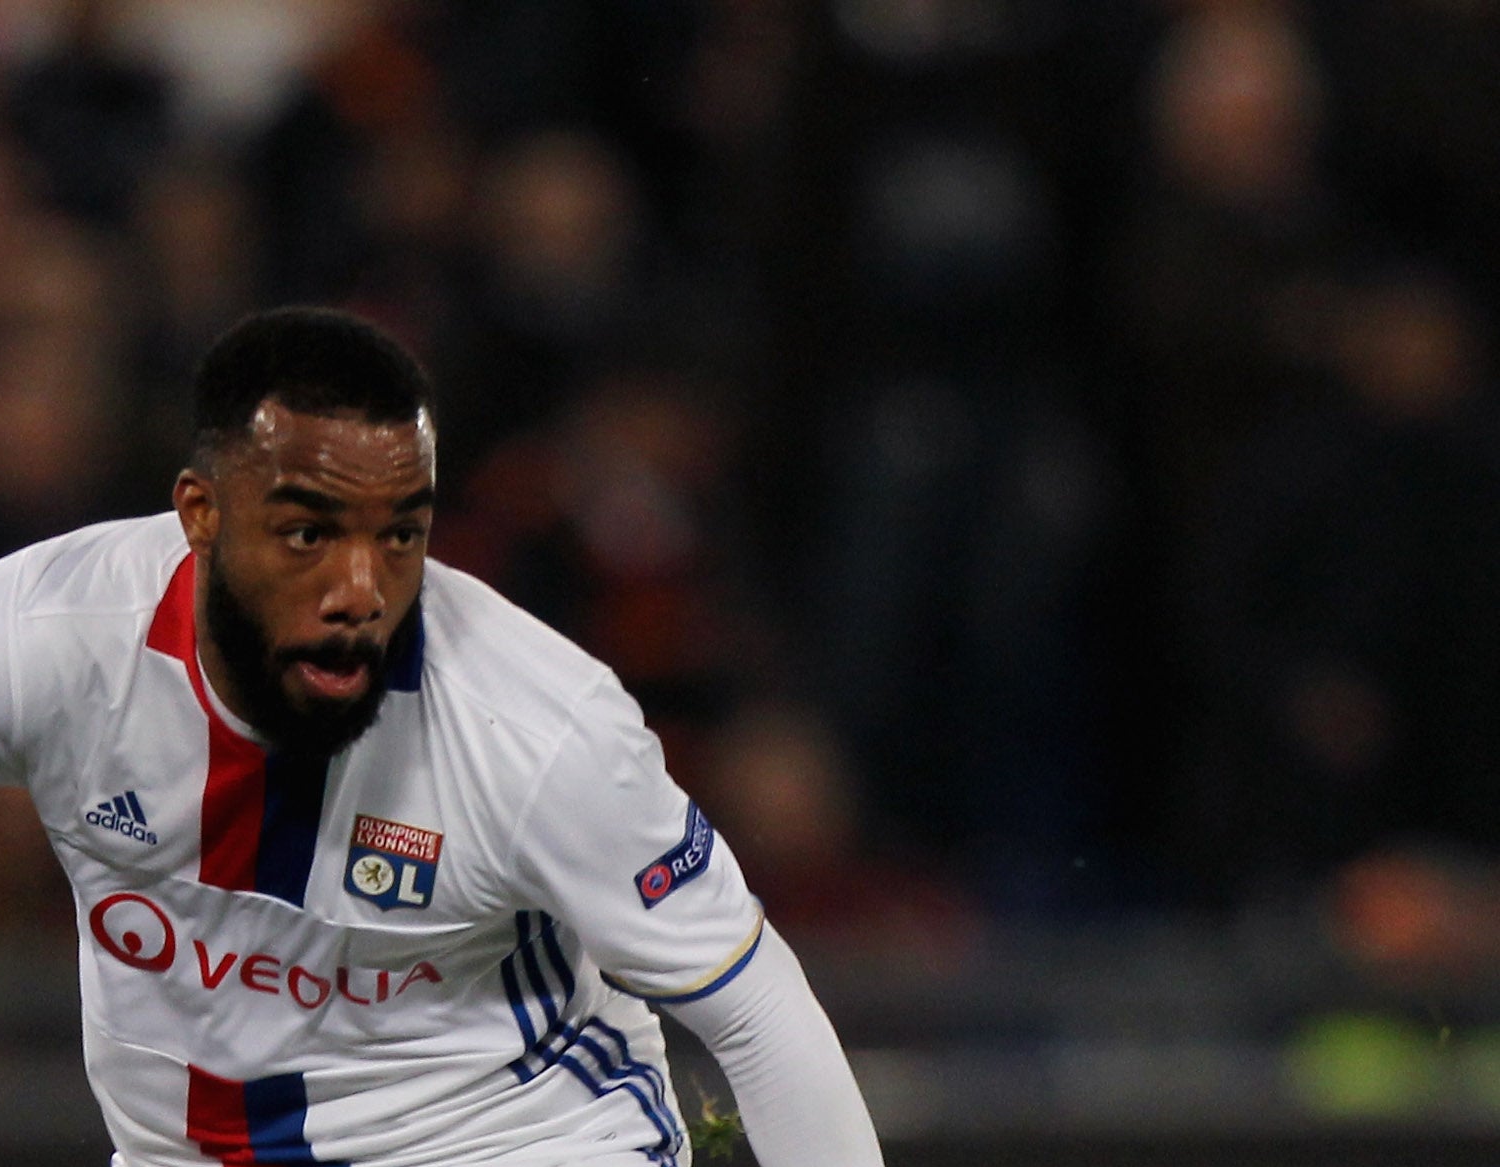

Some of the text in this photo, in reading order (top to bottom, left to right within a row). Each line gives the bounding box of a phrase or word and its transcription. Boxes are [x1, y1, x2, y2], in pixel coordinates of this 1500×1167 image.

[86, 811, 157, 845] adidas
[359, 819, 437, 845] OLYMPIQUE
[357, 830, 434, 859] LYONNAIS
[193, 939, 442, 1009] VEOLIA
